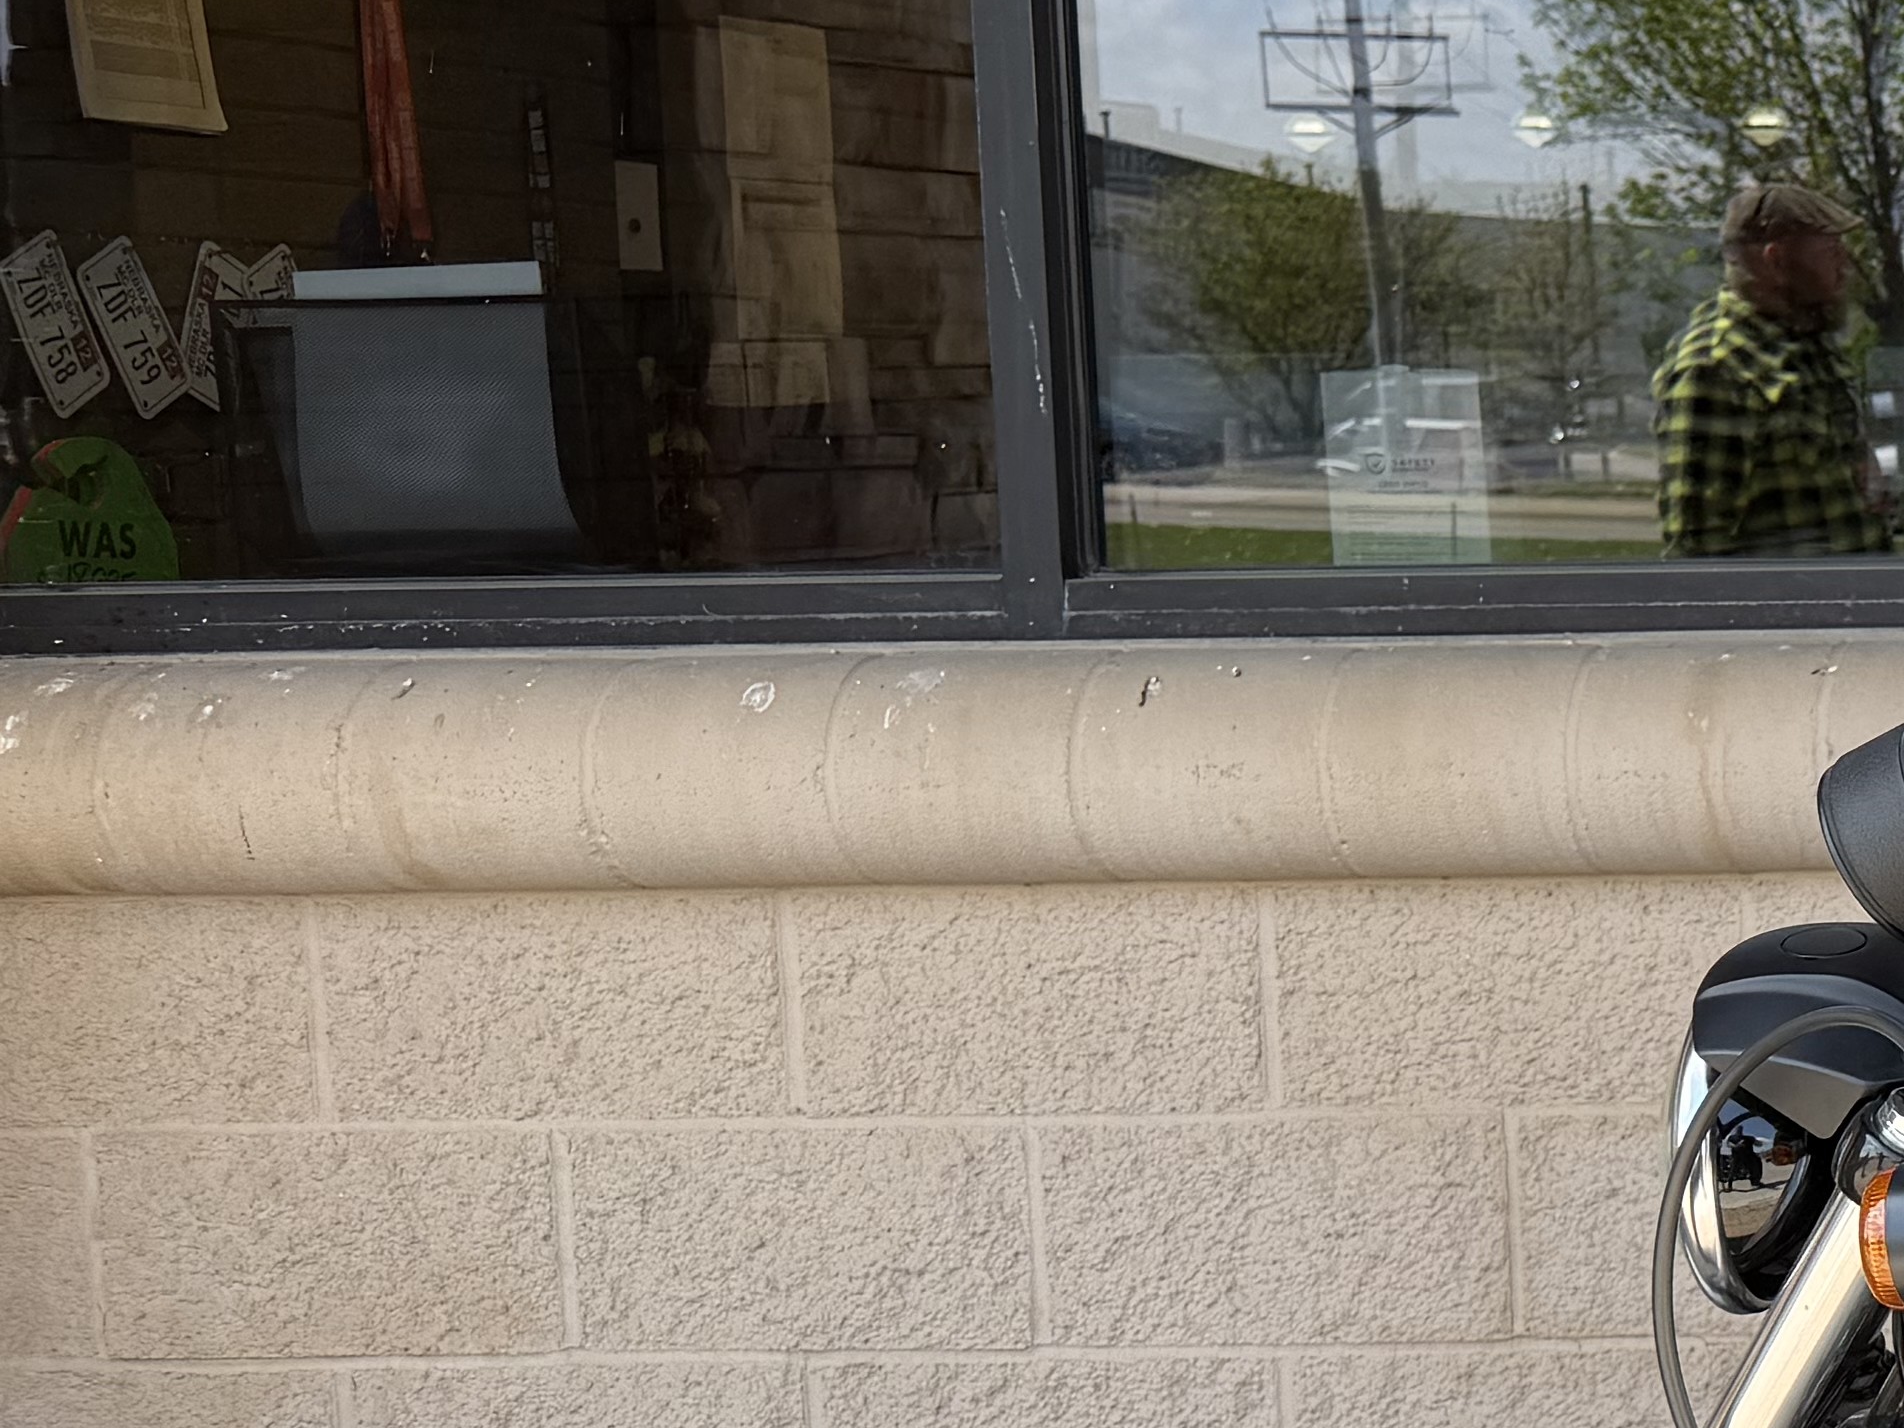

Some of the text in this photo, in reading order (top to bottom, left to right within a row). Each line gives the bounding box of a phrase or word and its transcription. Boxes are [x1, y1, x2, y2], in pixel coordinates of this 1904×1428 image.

[17, 268, 78, 385] ZDF 758
[96, 281, 163, 386] ZDF 759
[58, 519, 138, 560] WAS
